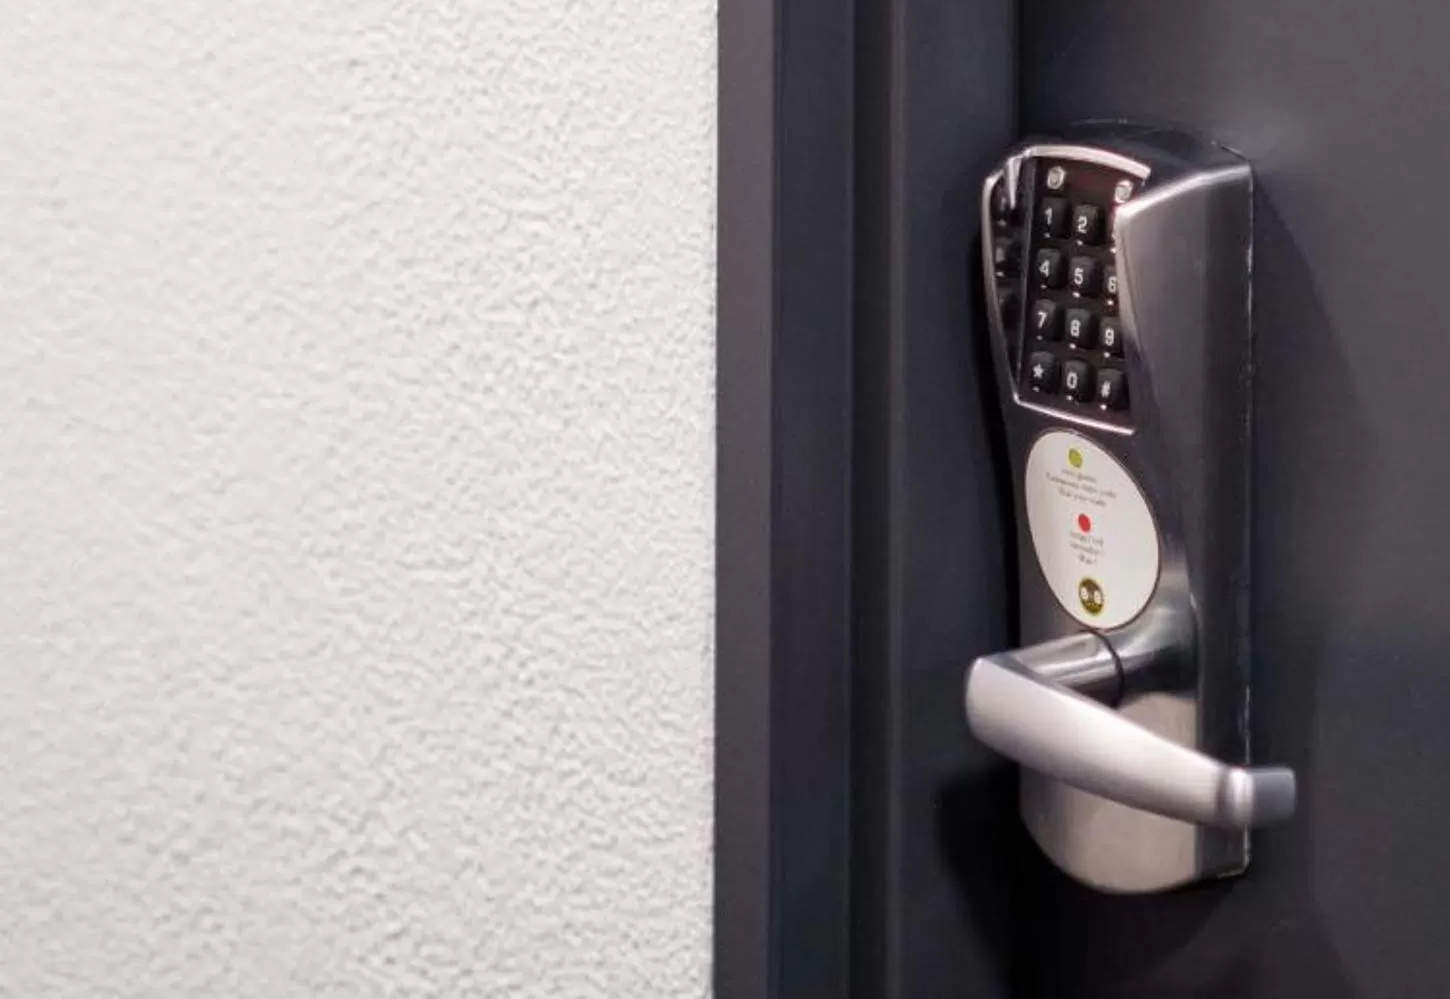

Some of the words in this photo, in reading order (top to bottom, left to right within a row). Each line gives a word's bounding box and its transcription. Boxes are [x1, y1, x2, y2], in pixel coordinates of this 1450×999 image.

[1045, 207, 1053, 225] 1
[1077, 216, 1088, 234] 2
[1040, 260, 1050, 277] 4
[1074, 268, 1084, 285] 5
[1107, 276, 1117, 293] 6
[1037, 311, 1048, 329] 7
[1070, 319, 1080, 337] 8
[1105, 328, 1115, 346] 9
[1067, 371, 1077, 389] 0
